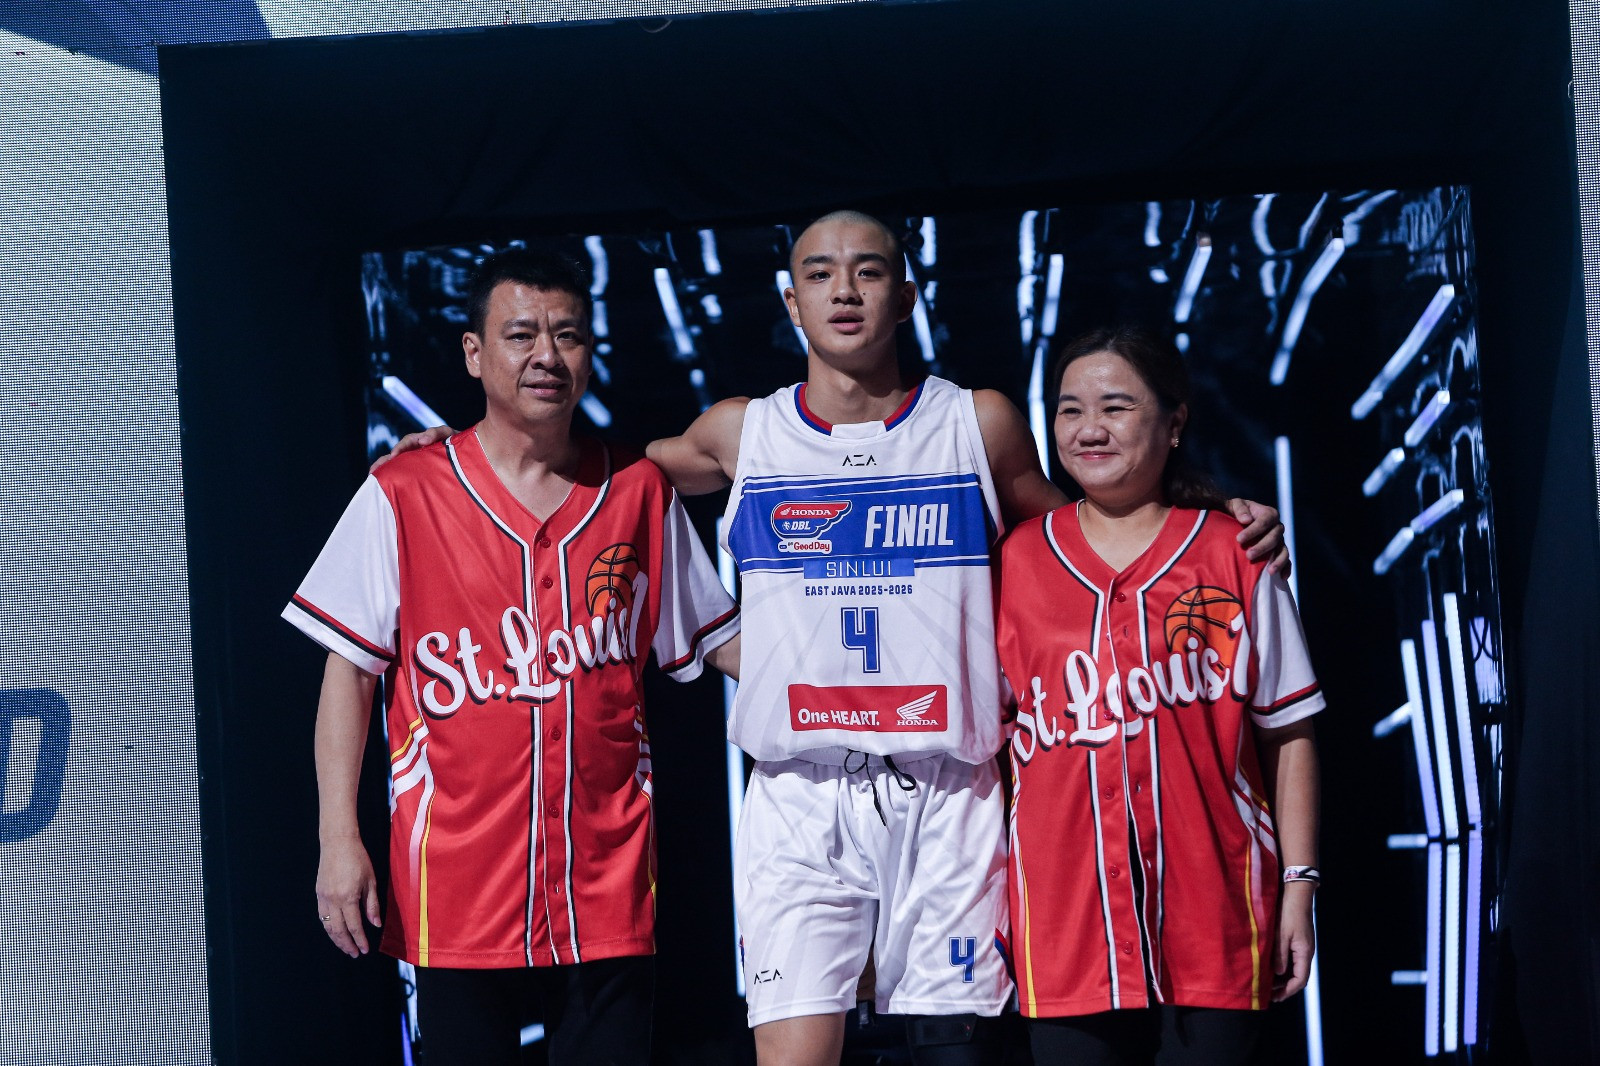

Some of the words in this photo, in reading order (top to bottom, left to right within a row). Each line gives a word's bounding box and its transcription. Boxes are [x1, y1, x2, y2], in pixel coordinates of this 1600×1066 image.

[791, 520, 811, 530] DBL
[865, 503, 954, 548] FINAL
[826, 560, 892, 577] SINLUI
[805, 586, 829, 596] EAST
[831, 585, 857, 596] JAVA
[858, 585, 913, 595] 2025-2026
[841, 607, 881, 673] 4
[798, 708, 829, 725] One
[830, 709, 880, 726] HEART.
[949, 936, 976, 983] 4
